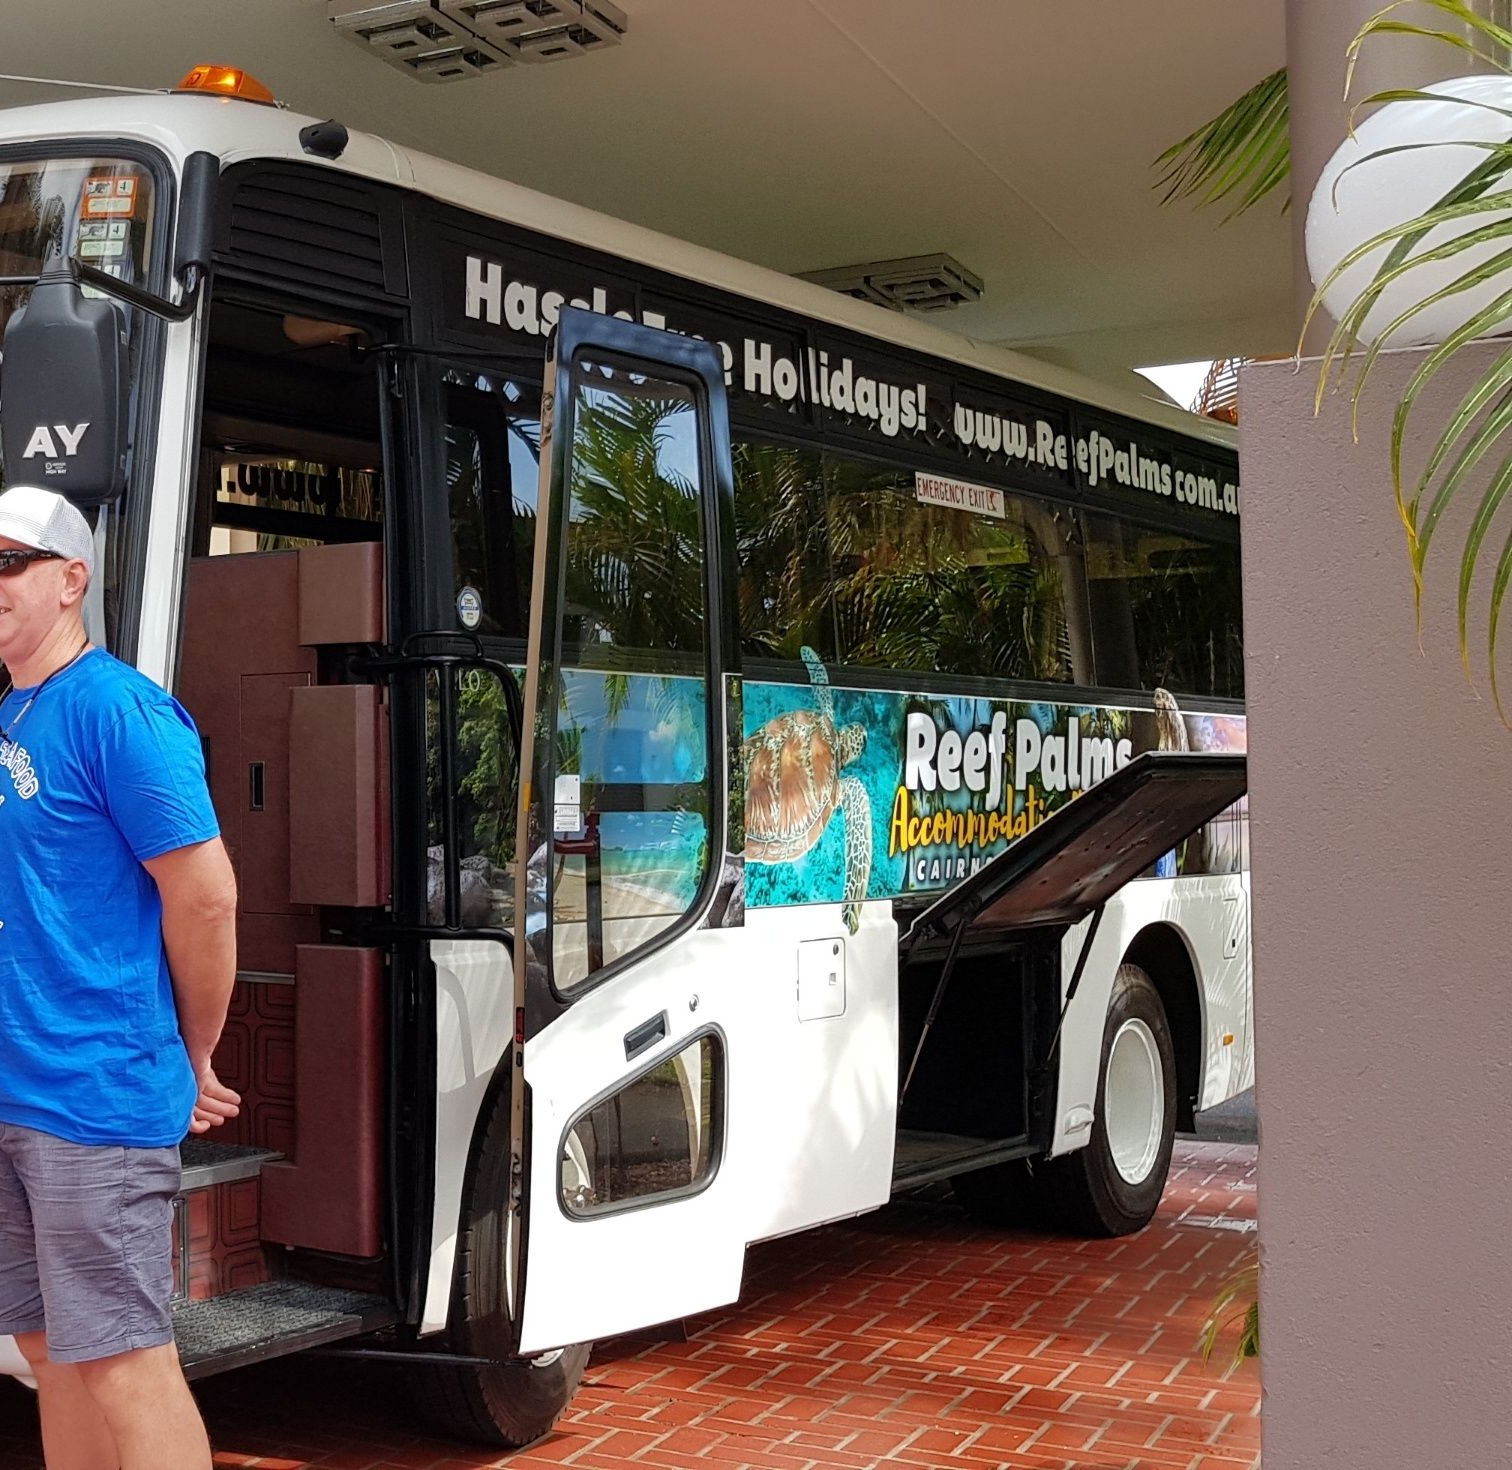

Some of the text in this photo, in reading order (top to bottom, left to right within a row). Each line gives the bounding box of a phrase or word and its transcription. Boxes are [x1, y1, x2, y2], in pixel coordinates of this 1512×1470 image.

[22, 422, 90, 459] AY
[744, 338, 928, 437] Holidays!
[954, 402, 1241, 517] www.ReefPalmscom.a
[917, 477, 985, 510] EMERGENCY EXIT
[905, 711, 1133, 810] Reef Palms
[889, 783, 1086, 858] Accommodati
[917, 857, 993, 880] CAIRN
